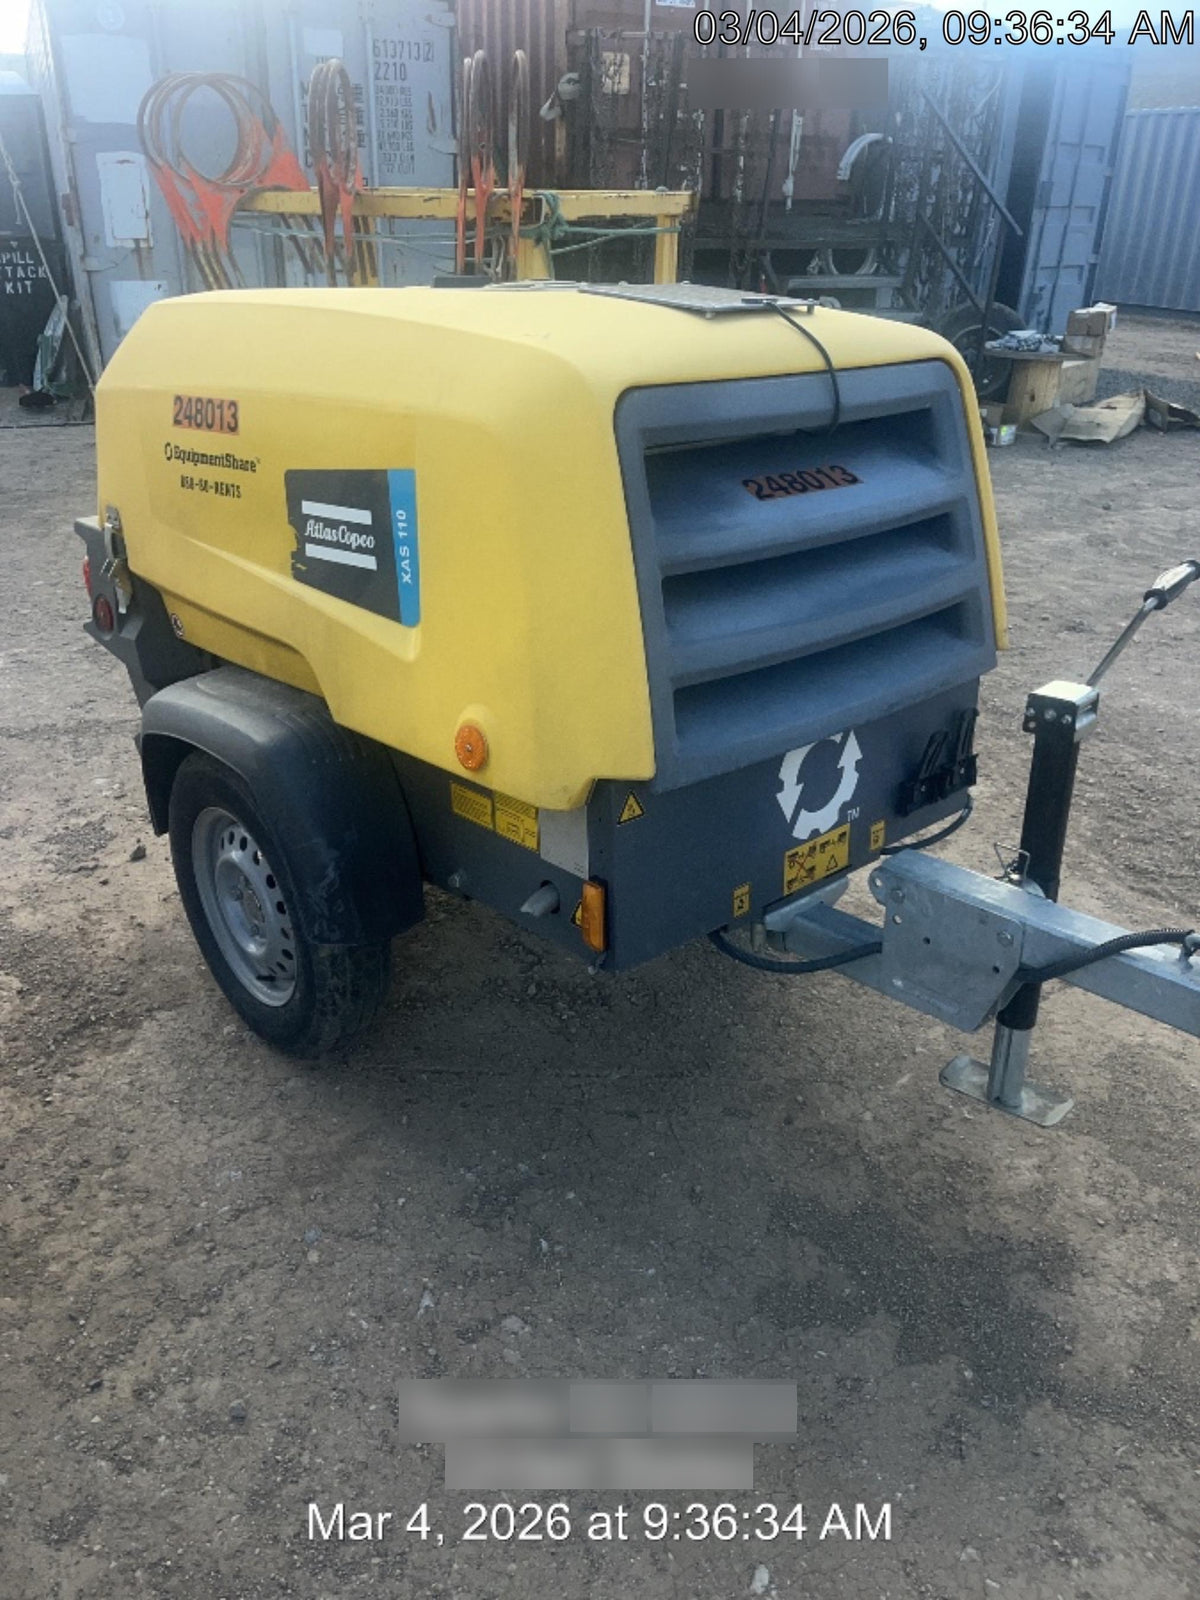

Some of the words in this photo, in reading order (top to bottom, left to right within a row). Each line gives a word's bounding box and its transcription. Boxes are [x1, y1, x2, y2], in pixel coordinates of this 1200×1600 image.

[375, 61, 407, 82] 2210
[0, 251, 35, 264] PILL
[0, 265, 48, 278] TACK
[5, 280, 33, 294] KIT
[173, 395, 239, 433] 248013
[742, 465, 858, 501] 248013
[395, 509, 408, 538] 110
[399, 545, 412, 584] XAS
